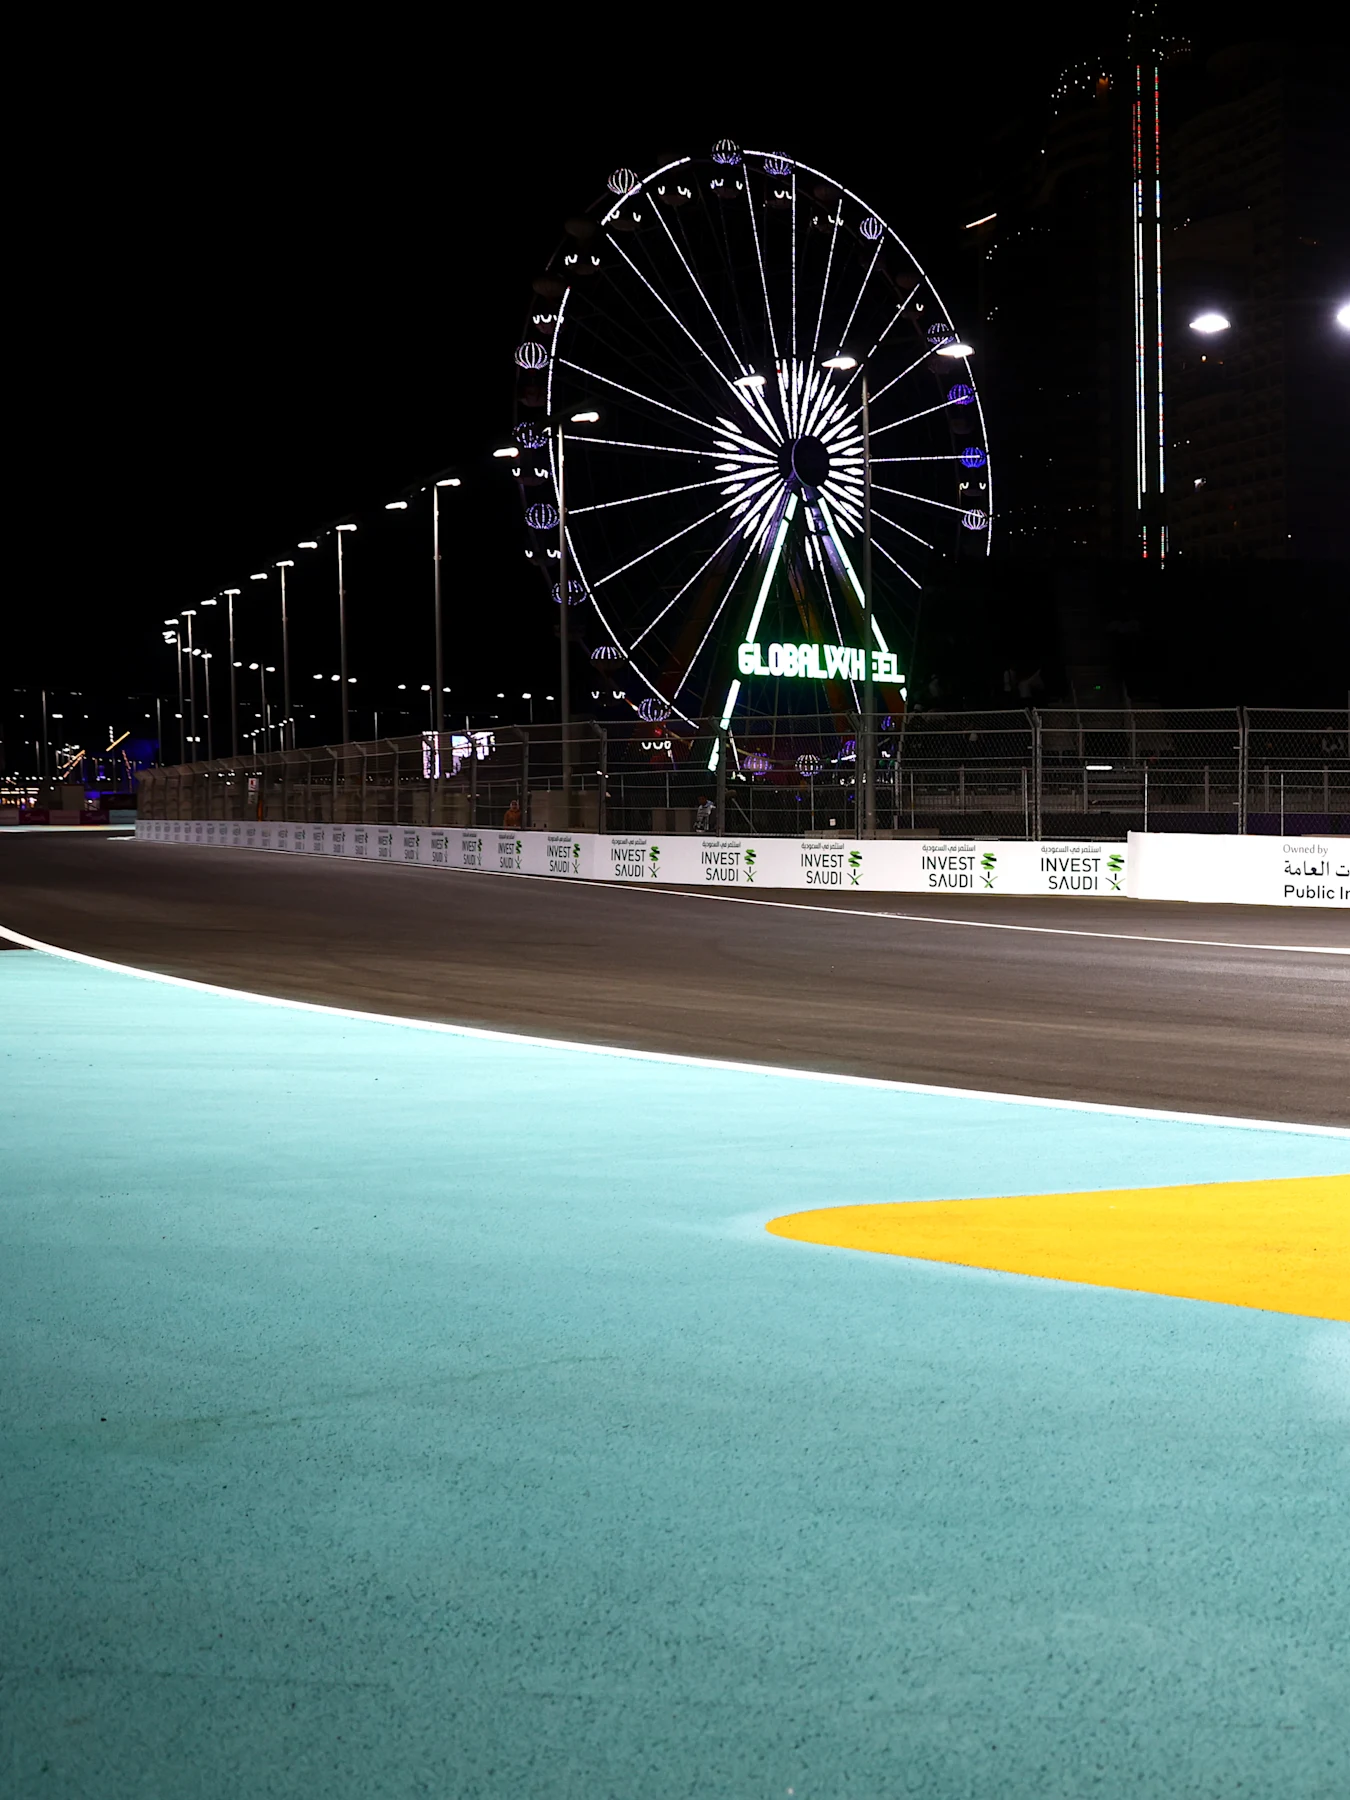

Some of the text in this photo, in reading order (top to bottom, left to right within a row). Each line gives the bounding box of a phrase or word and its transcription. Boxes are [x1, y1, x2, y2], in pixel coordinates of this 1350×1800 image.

[497, 842, 515, 855] INVEST
[546, 845, 572, 859] INVEST
[610, 848, 647, 862] INVEST
[1282, 843, 1329, 857] Owned by
[499, 856, 514, 869] SAUDI
[549, 859, 570, 873] SAUDI
[701, 851, 741, 866] INVEST
[800, 853, 845, 868] INVEST
[922, 855, 976, 871] INVEST
[1040, 857, 1101, 873] INVEST
[614, 863, 645, 878] SAUDI
[705, 867, 739, 882] SAUDI
[1285, 861, 1329, 876] العامة
[806, 870, 842, 885] SAUDI
[928, 873, 973, 888] SAUDI
[1048, 875, 1098, 891] SAUDI
[1285, 885, 1334, 899] Public
